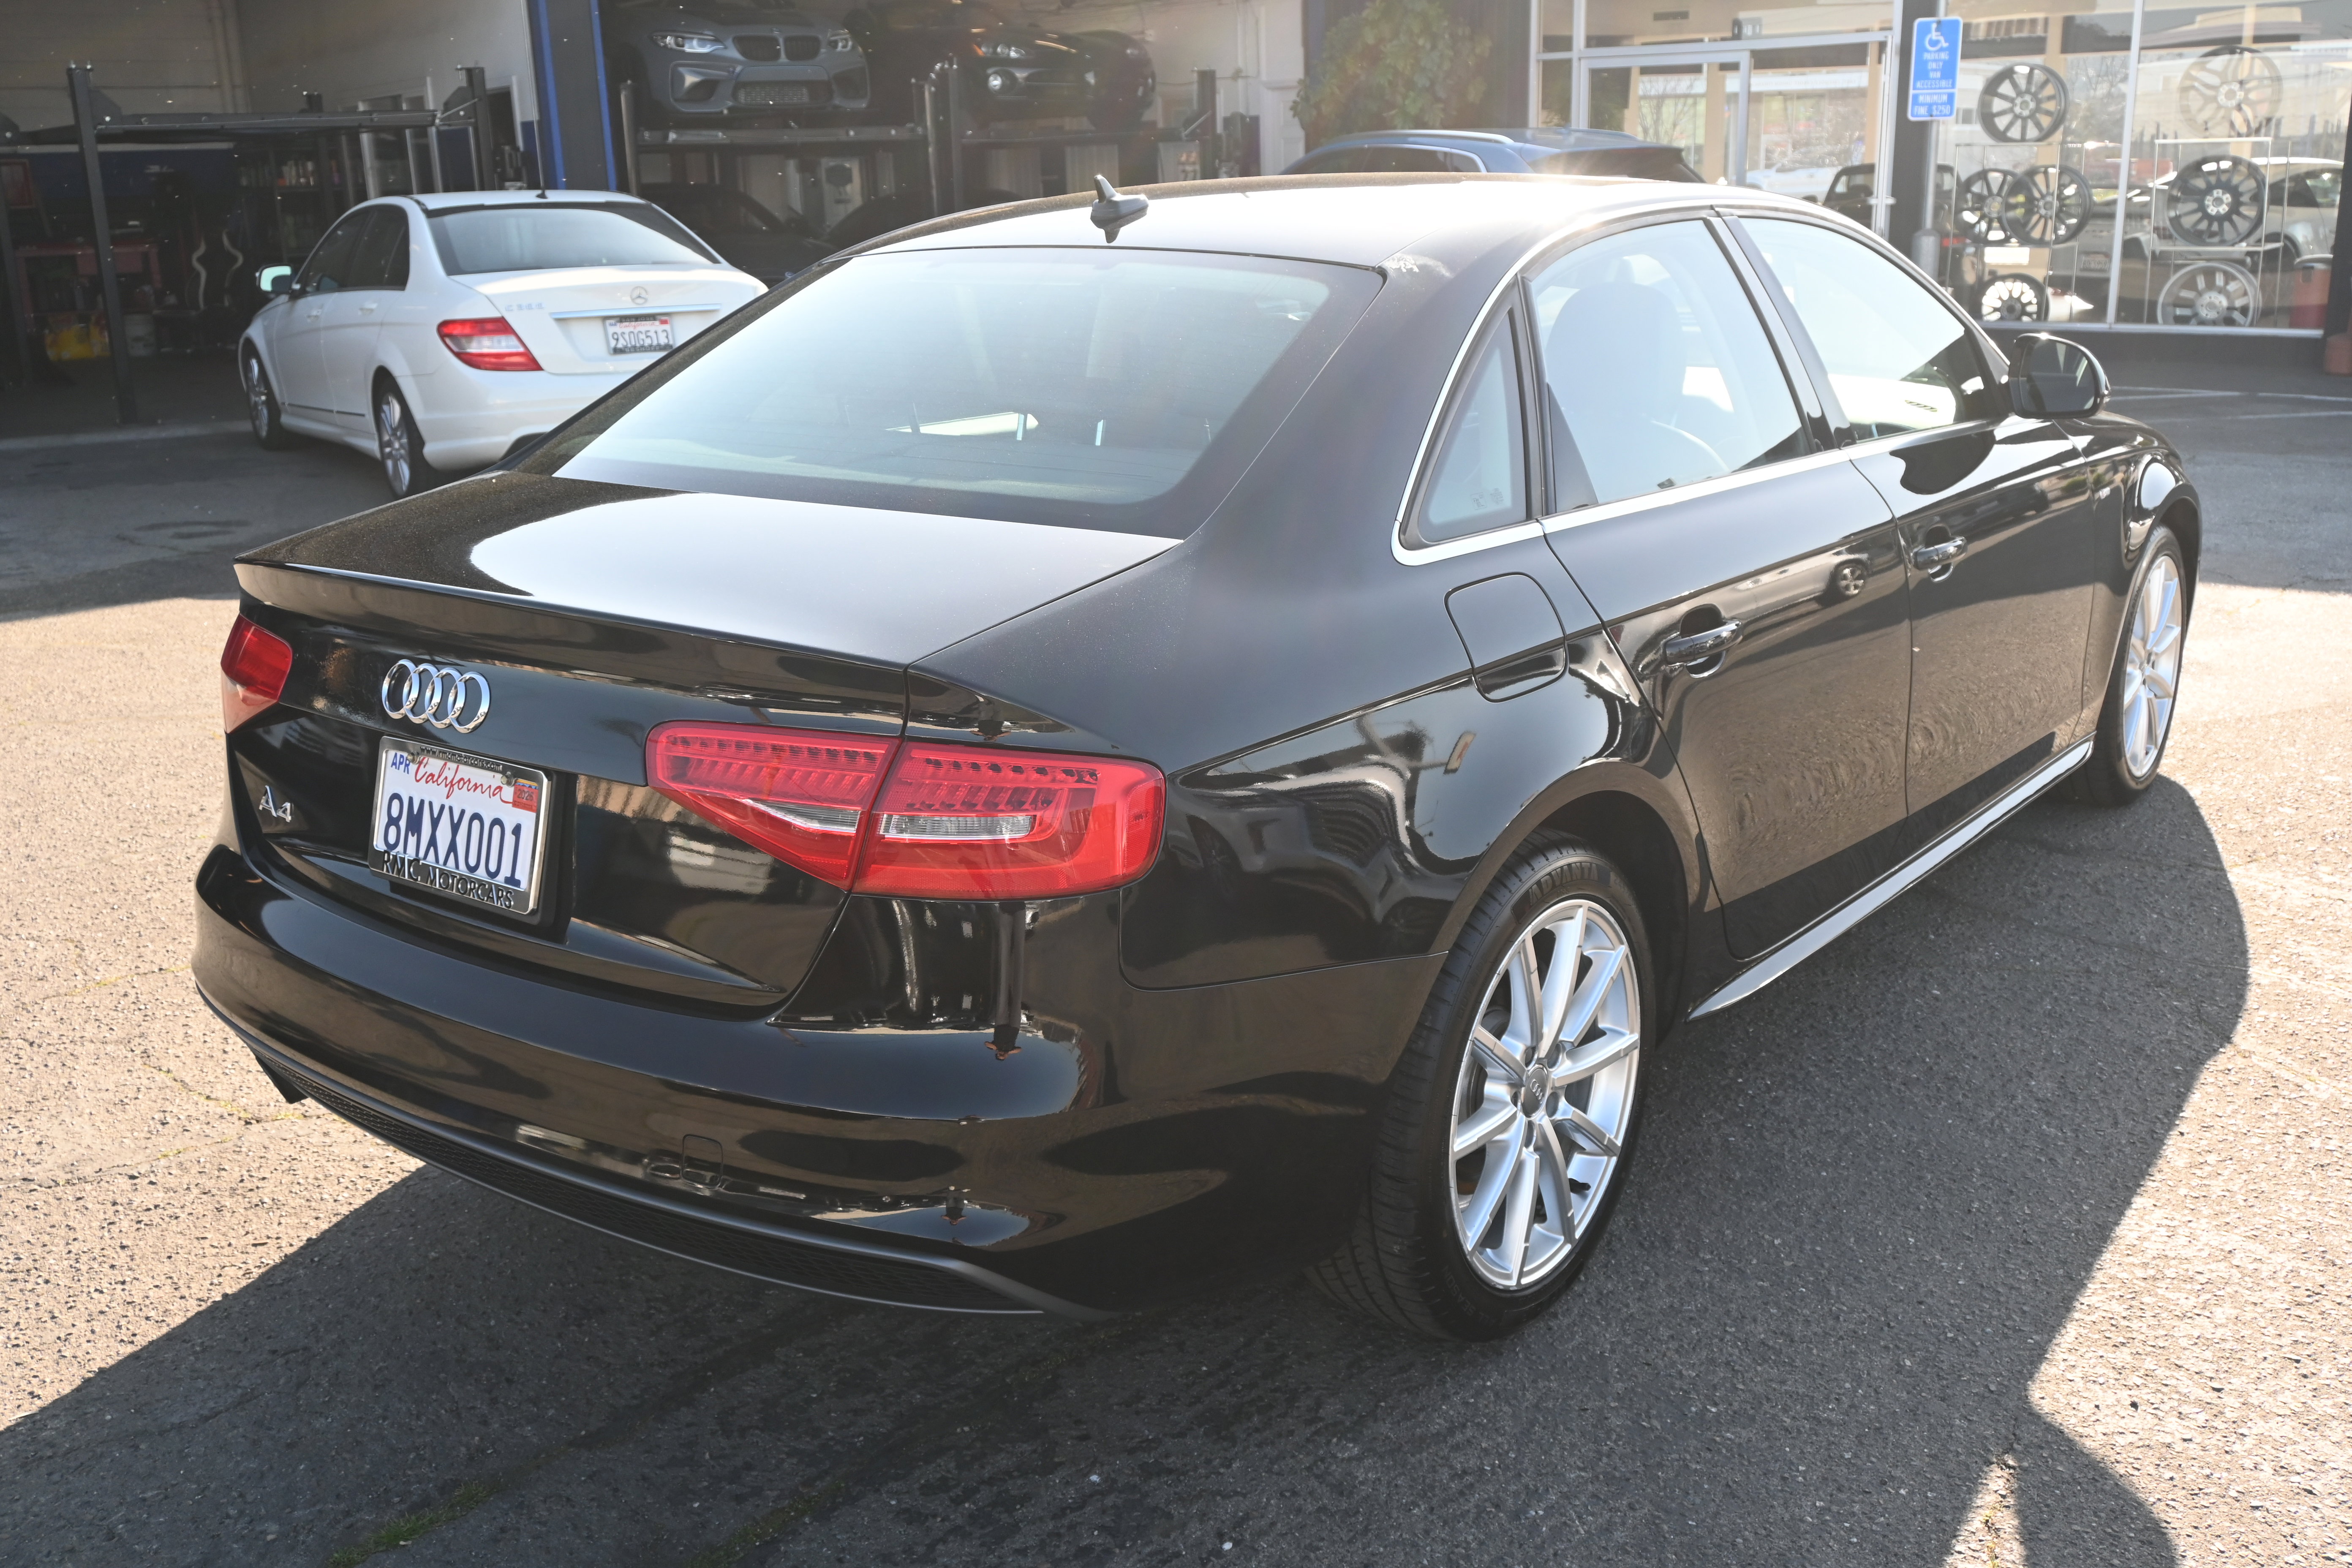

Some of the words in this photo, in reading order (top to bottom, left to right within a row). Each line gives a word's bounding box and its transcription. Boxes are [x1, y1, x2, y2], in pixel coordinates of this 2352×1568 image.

[1924, 51, 1949, 60] PARKING
[1916, 79, 1952, 88] ACCESSIBLE
[1914, 106, 1928, 115] FINE
[1933, 105, 1950, 115] $250
[1919, 94, 1947, 103] MINIMUM
[619, 321, 659, 330] California
[390, 752, 410, 775] APR
[420, 746, 503, 771] www.rmcmotorcars.com
[414, 756, 513, 804] California
[259, 784, 292, 823] A4
[517, 788, 534, 801] 2026
[383, 792, 522, 888] 8MXX001
[382, 849, 422, 882] RMC
[427, 866, 514, 909] MOTORCARS
[1528, 861, 1599, 906] ADVANTA
